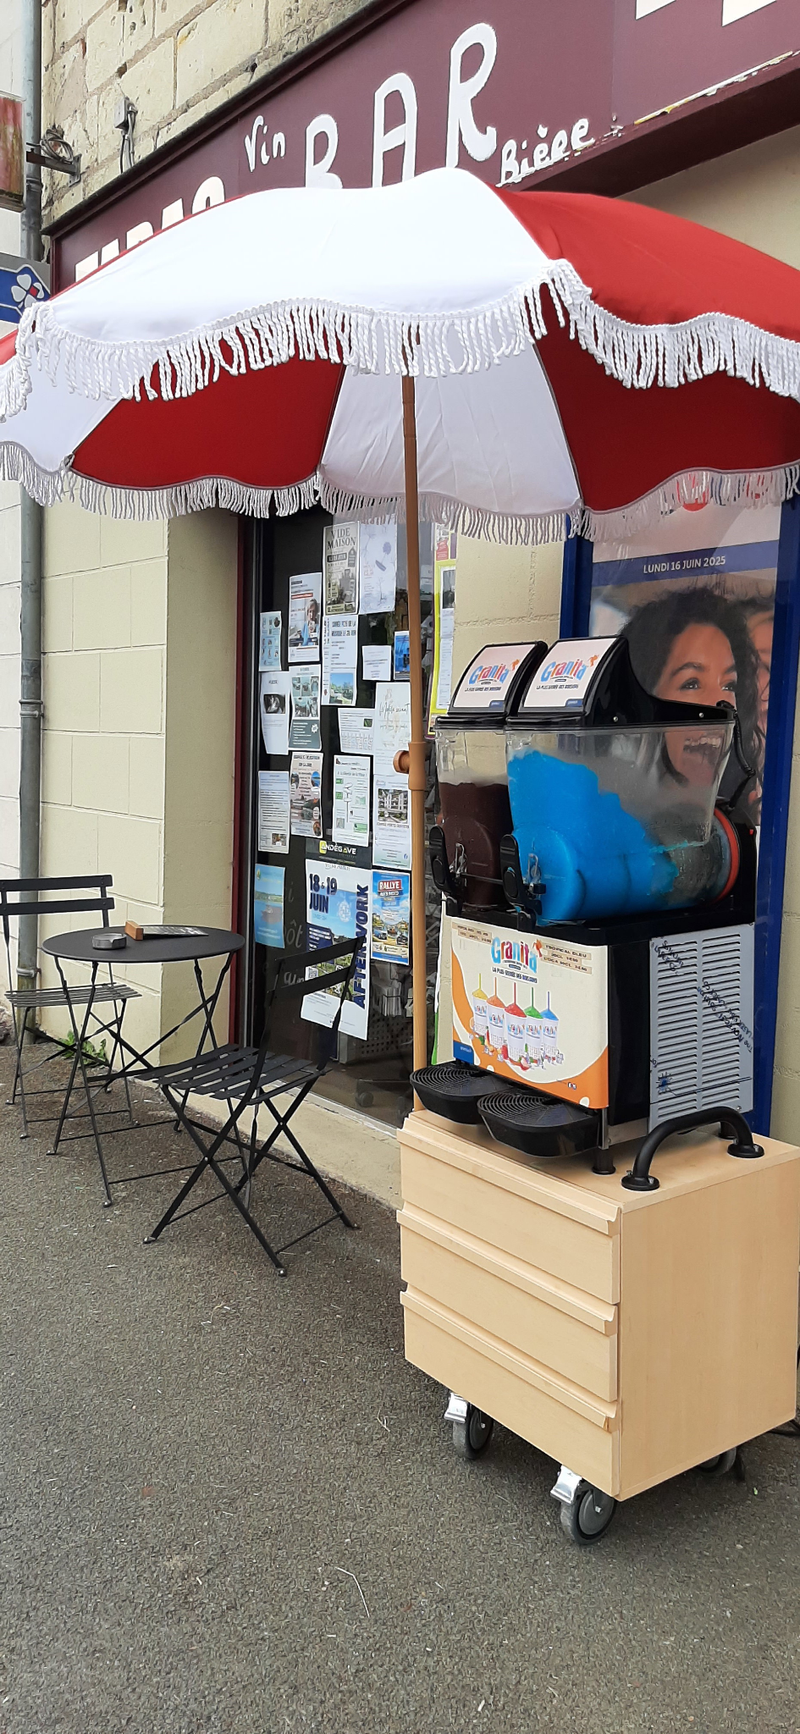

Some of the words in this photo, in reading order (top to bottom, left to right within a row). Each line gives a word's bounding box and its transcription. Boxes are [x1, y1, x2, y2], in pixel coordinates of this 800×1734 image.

[305, 23, 497, 188] BAR
[244, 115, 286, 173] Vin
[498, 118, 595, 187] Bière
[327, 536, 356, 550] MAISON
[330, 527, 351, 539] VIDE
[643, 562, 670, 574] LUNDI
[671, 562, 681, 571] 16
[682, 559, 701, 570] JUIN
[703, 555, 726, 567] 2025
[468, 664, 509, 685] Granita
[540, 659, 587, 682] Granita
[309, 873, 320, 892] 18
[326, 877, 338, 895] 19
[379, 881, 400, 890] RALLYE
[309, 892, 329, 914] JUIN
[491, 937, 537, 974] Granita
